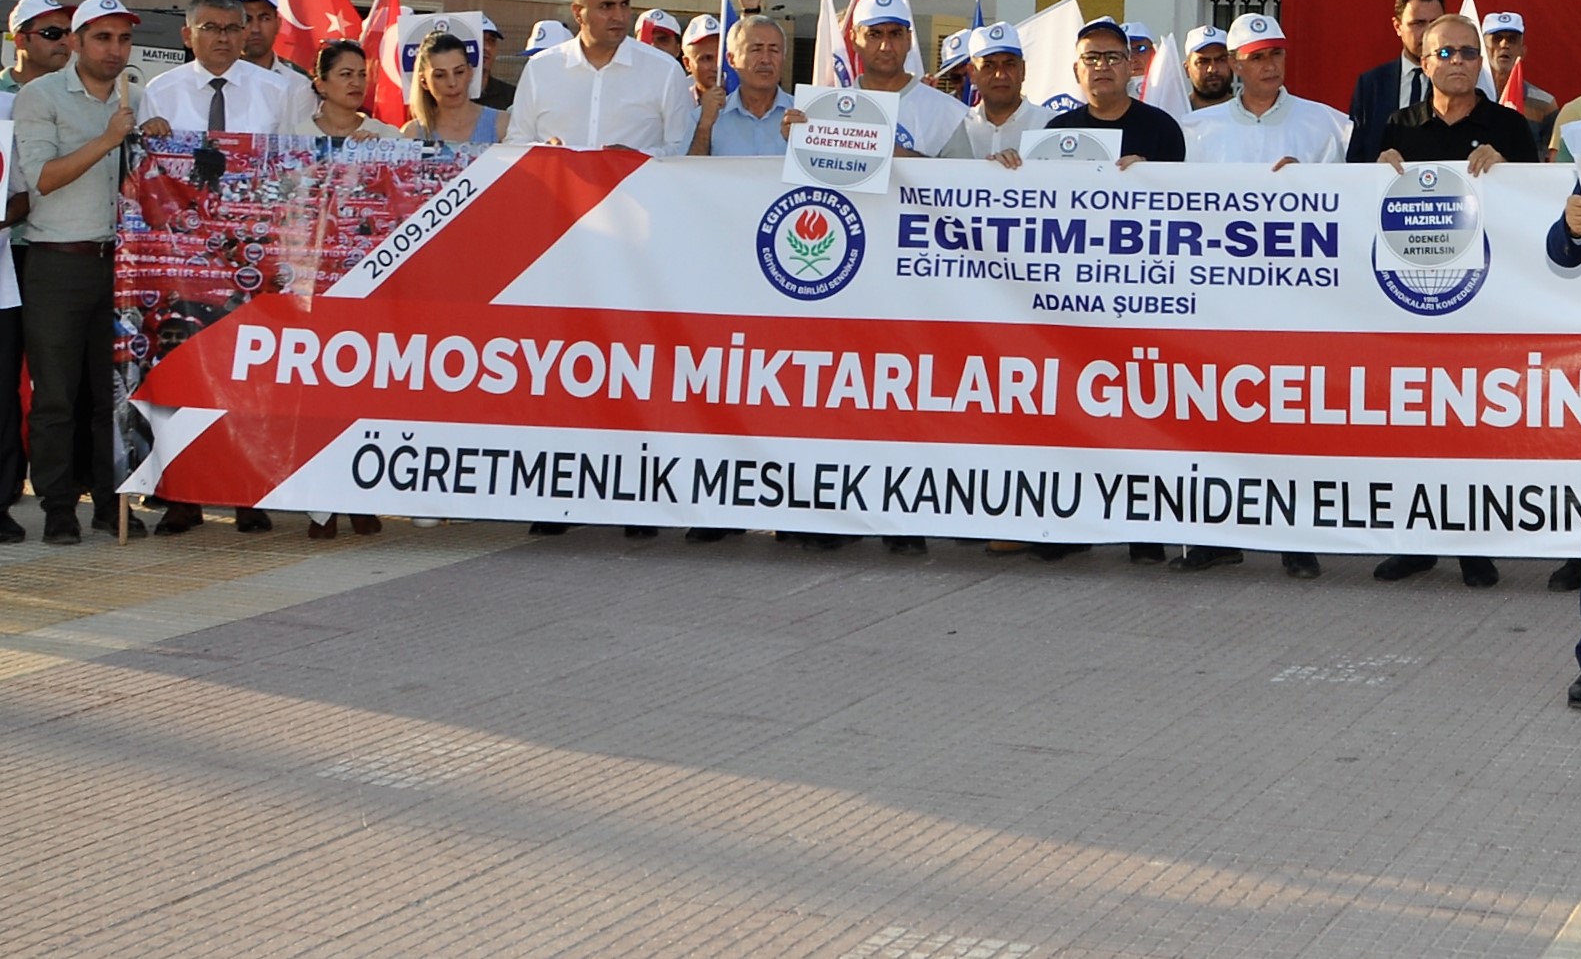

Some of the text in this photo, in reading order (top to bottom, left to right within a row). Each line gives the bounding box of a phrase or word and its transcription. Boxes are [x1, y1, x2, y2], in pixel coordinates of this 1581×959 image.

[142, 49, 185, 61] MATHIEU
[808, 125, 878, 139] 8 YILA UZMAN
[805, 136, 877, 151] ÖĞRETMENLİK
[810, 157, 867, 172] VERİLSİN
[900, 186, 1340, 213] MEMUR-SEN KONFEDERASYONU
[1387, 200, 1466, 213] ÖĞRETİM YILIN
[1404, 215, 1453, 226] HAZIRLIK
[363, 178, 478, 280] 20.09.2022
[1408, 233, 1450, 243] ÖDENEĞİ
[1403, 246, 1455, 255] ARTIRILSIN
[896, 253, 1340, 287] EĞİTİMCİLER BİRLİĞİ SENDİKASI
[1032, 292, 1197, 319] ADANA ŞUBESİ
[231, 323, 656, 402] PROMOSYON
[671, 332, 1060, 416] MİKTARLARI
[351, 431, 681, 505] ÖĞRETMENLİK
[691, 458, 872, 513] MESLEK
[881, 465, 1083, 519] KANUNU
[1095, 463, 1296, 527] YENİDEN
[1312, 481, 1394, 530] ELE
